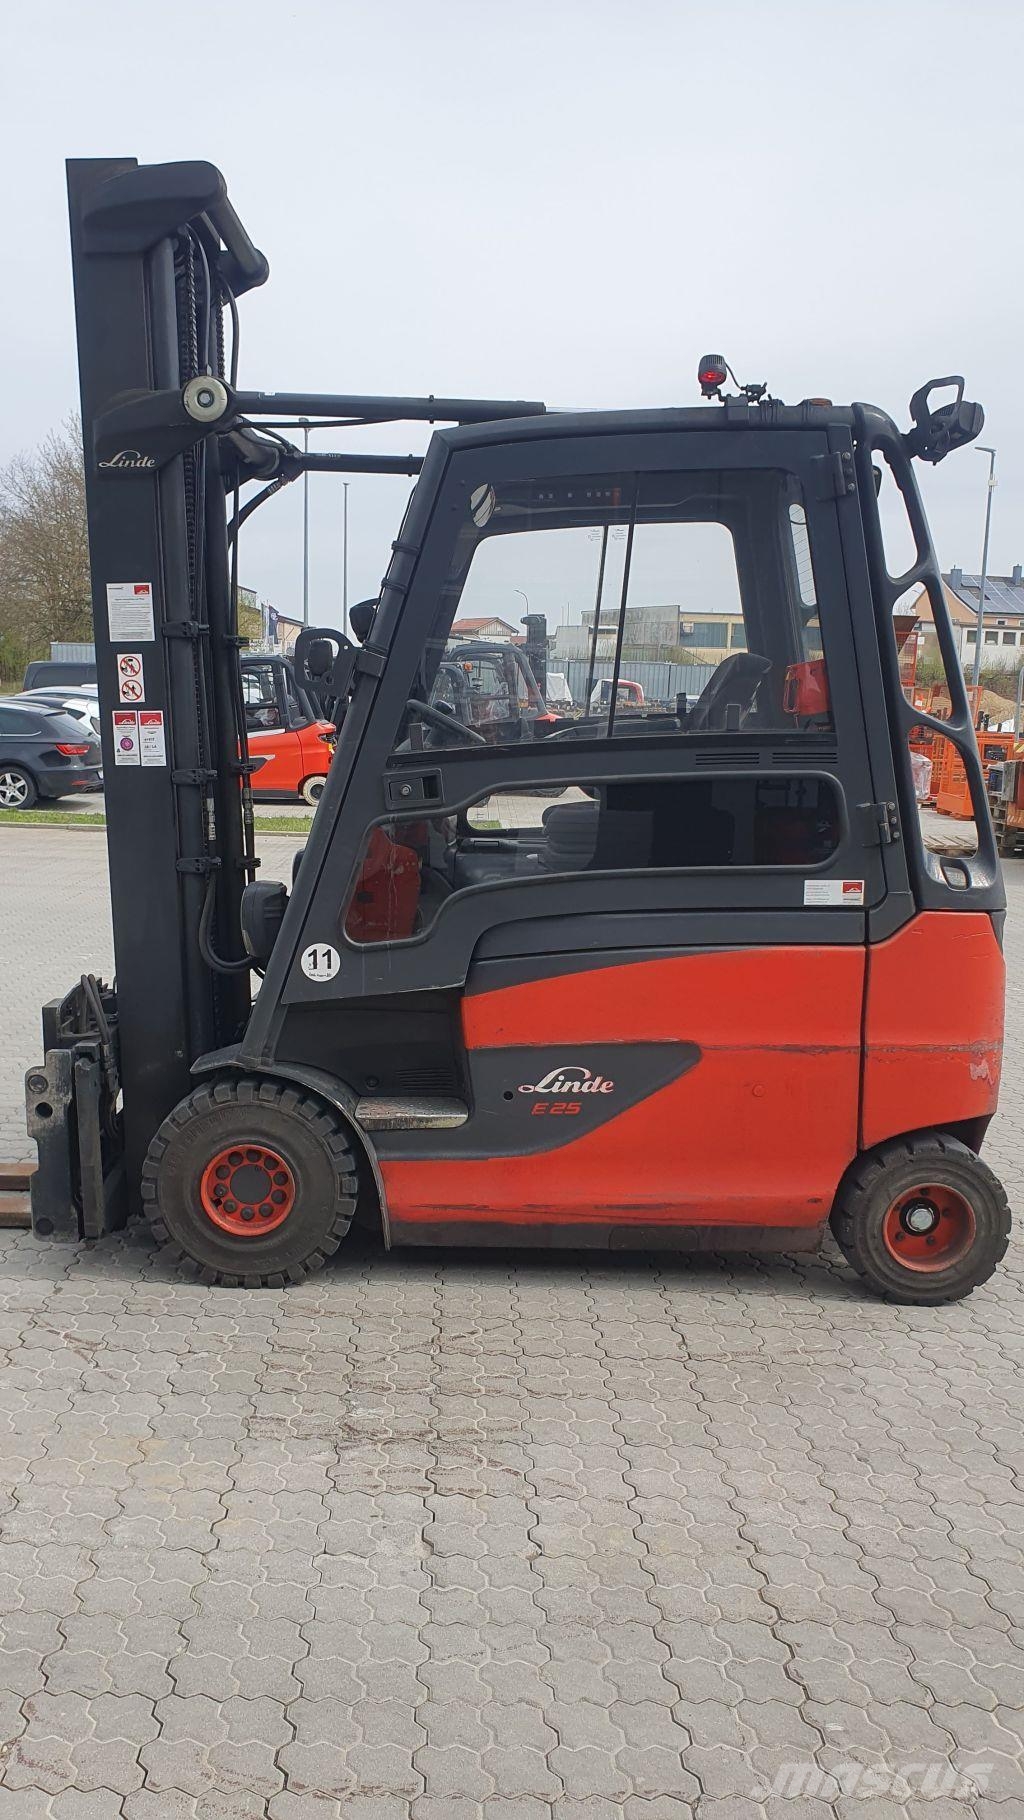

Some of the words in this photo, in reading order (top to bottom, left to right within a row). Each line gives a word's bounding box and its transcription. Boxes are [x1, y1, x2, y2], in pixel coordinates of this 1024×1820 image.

[98, 449, 156, 467] Linde
[308, 949, 332, 969] 11
[517, 1066, 614, 1093] Linde
